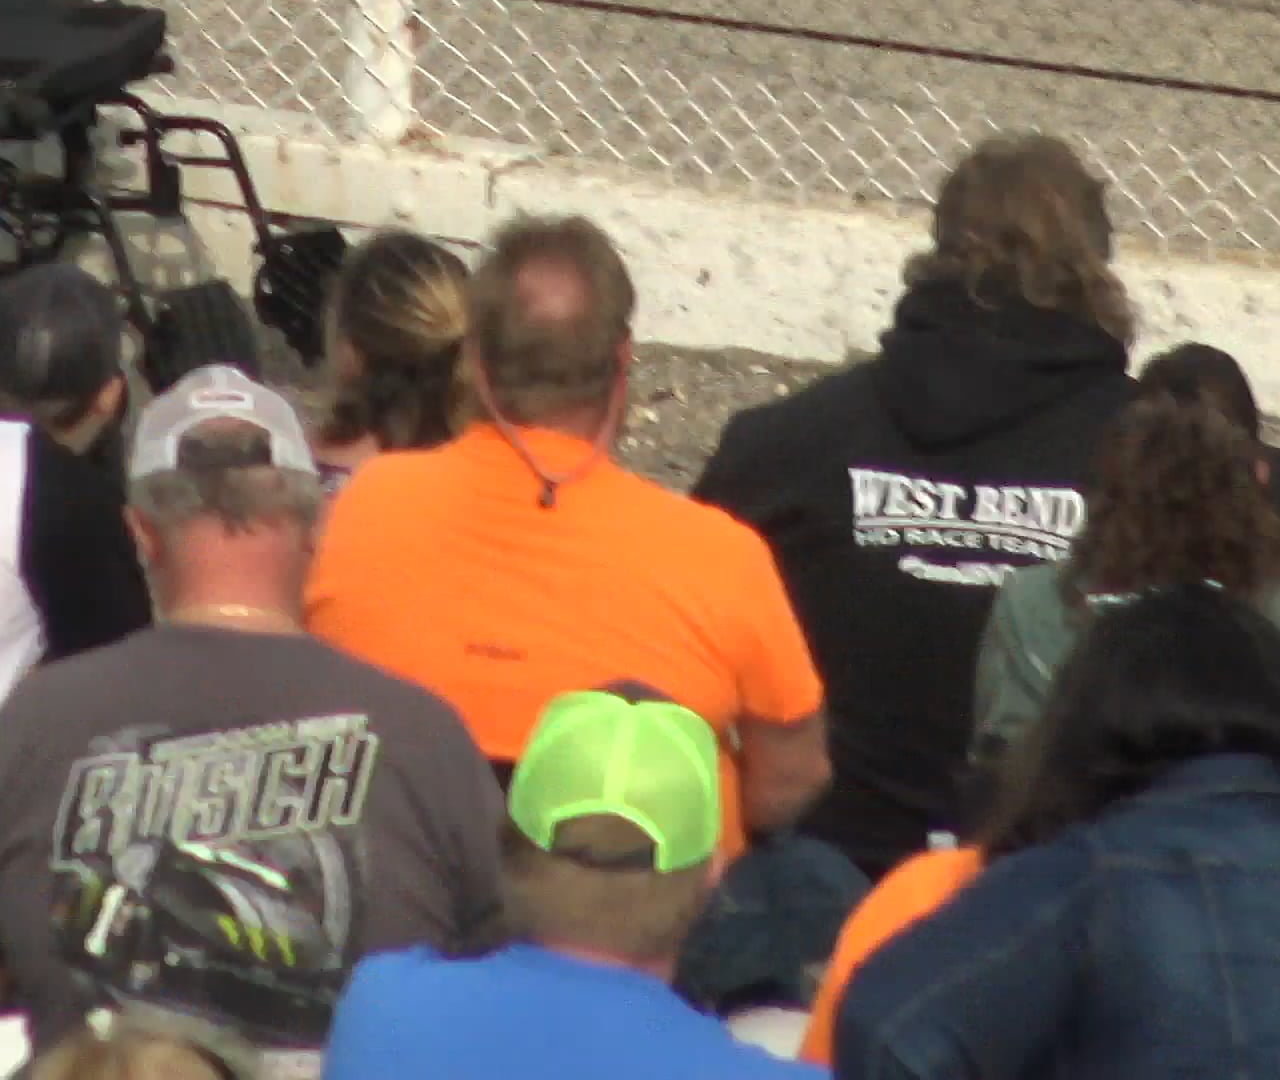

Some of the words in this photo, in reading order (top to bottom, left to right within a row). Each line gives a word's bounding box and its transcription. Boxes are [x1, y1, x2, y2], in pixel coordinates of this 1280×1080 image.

[847, 467, 968, 519] WEST
[971, 483, 1088, 537] BEND
[904, 527, 983, 549] RACE
